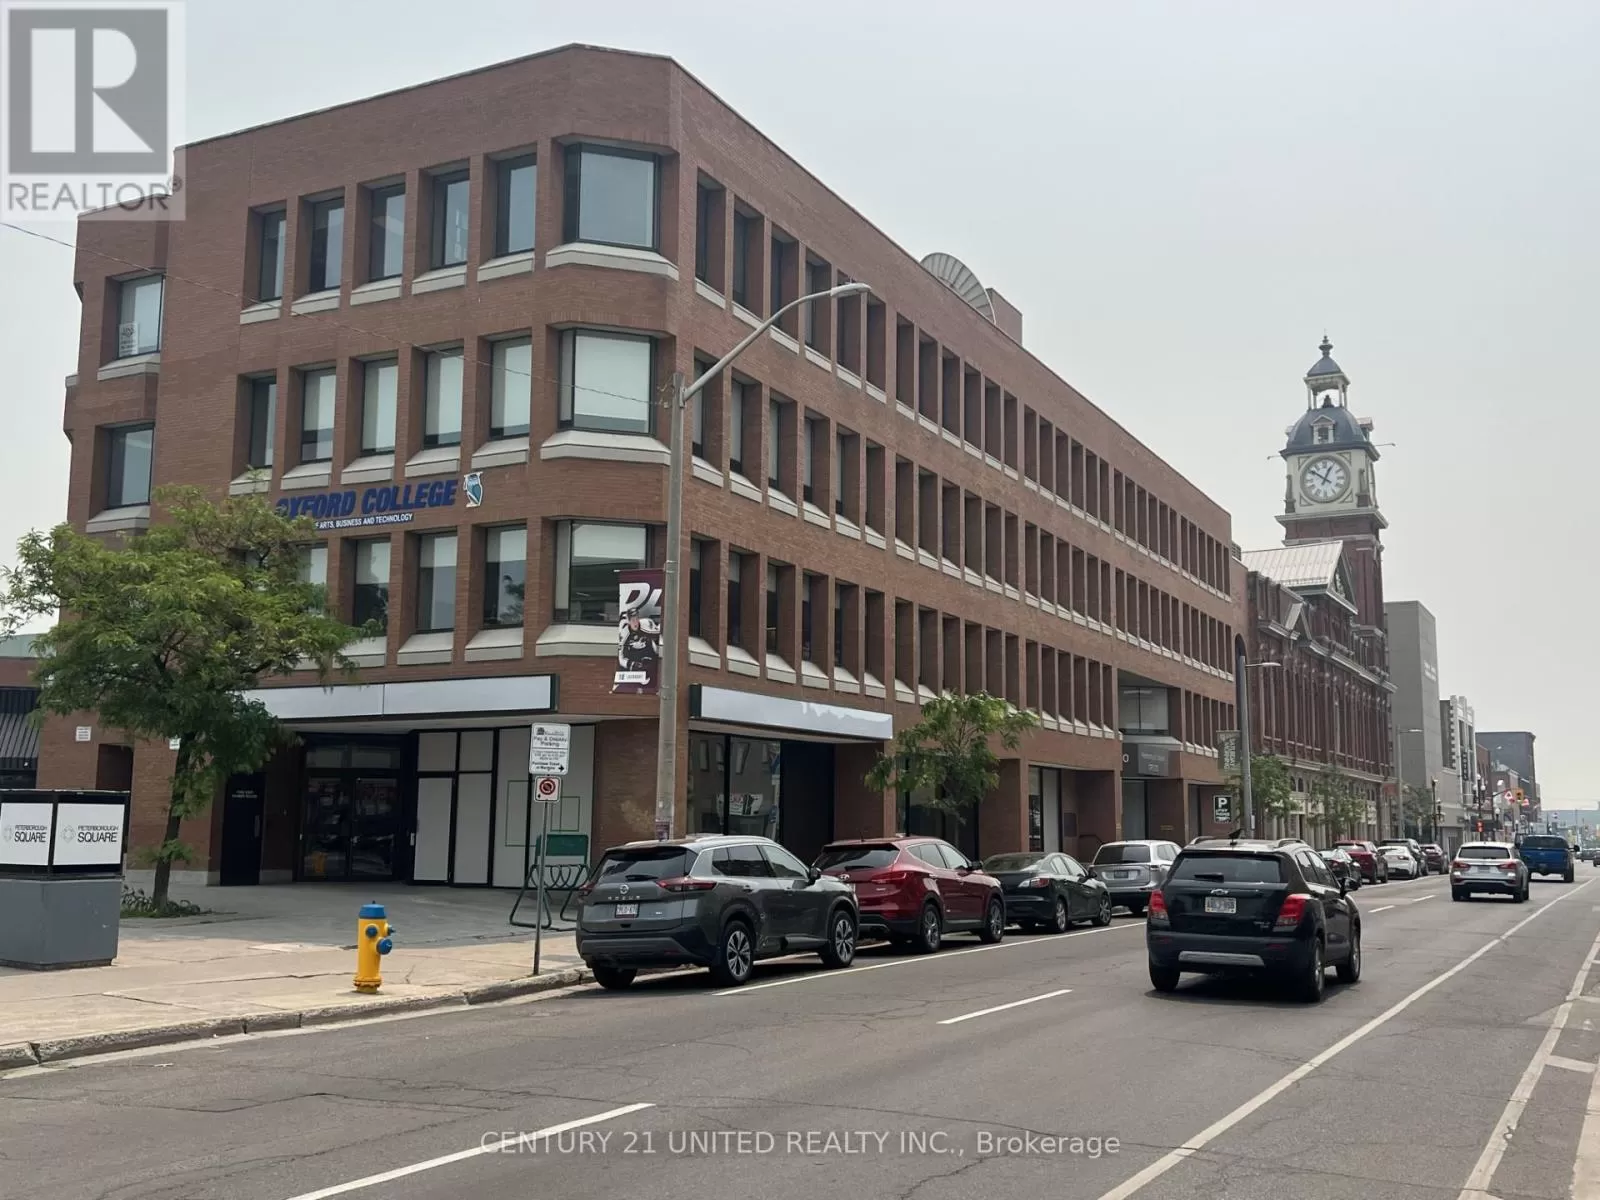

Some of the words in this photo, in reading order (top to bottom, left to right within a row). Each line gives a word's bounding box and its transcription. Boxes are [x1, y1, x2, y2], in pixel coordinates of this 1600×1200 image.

[361, 479, 459, 514] COLLEGE
[319, 520, 335, 530] ARTS,
[335, 517, 362, 529] BUSINESS
[363, 516, 375, 526] AND
[375, 513, 413, 524] TECHNOLOGY
[1218, 797, 1228, 809] P
[14, 831, 47, 843] SQUARE
[77, 831, 118, 843] SQUARE
